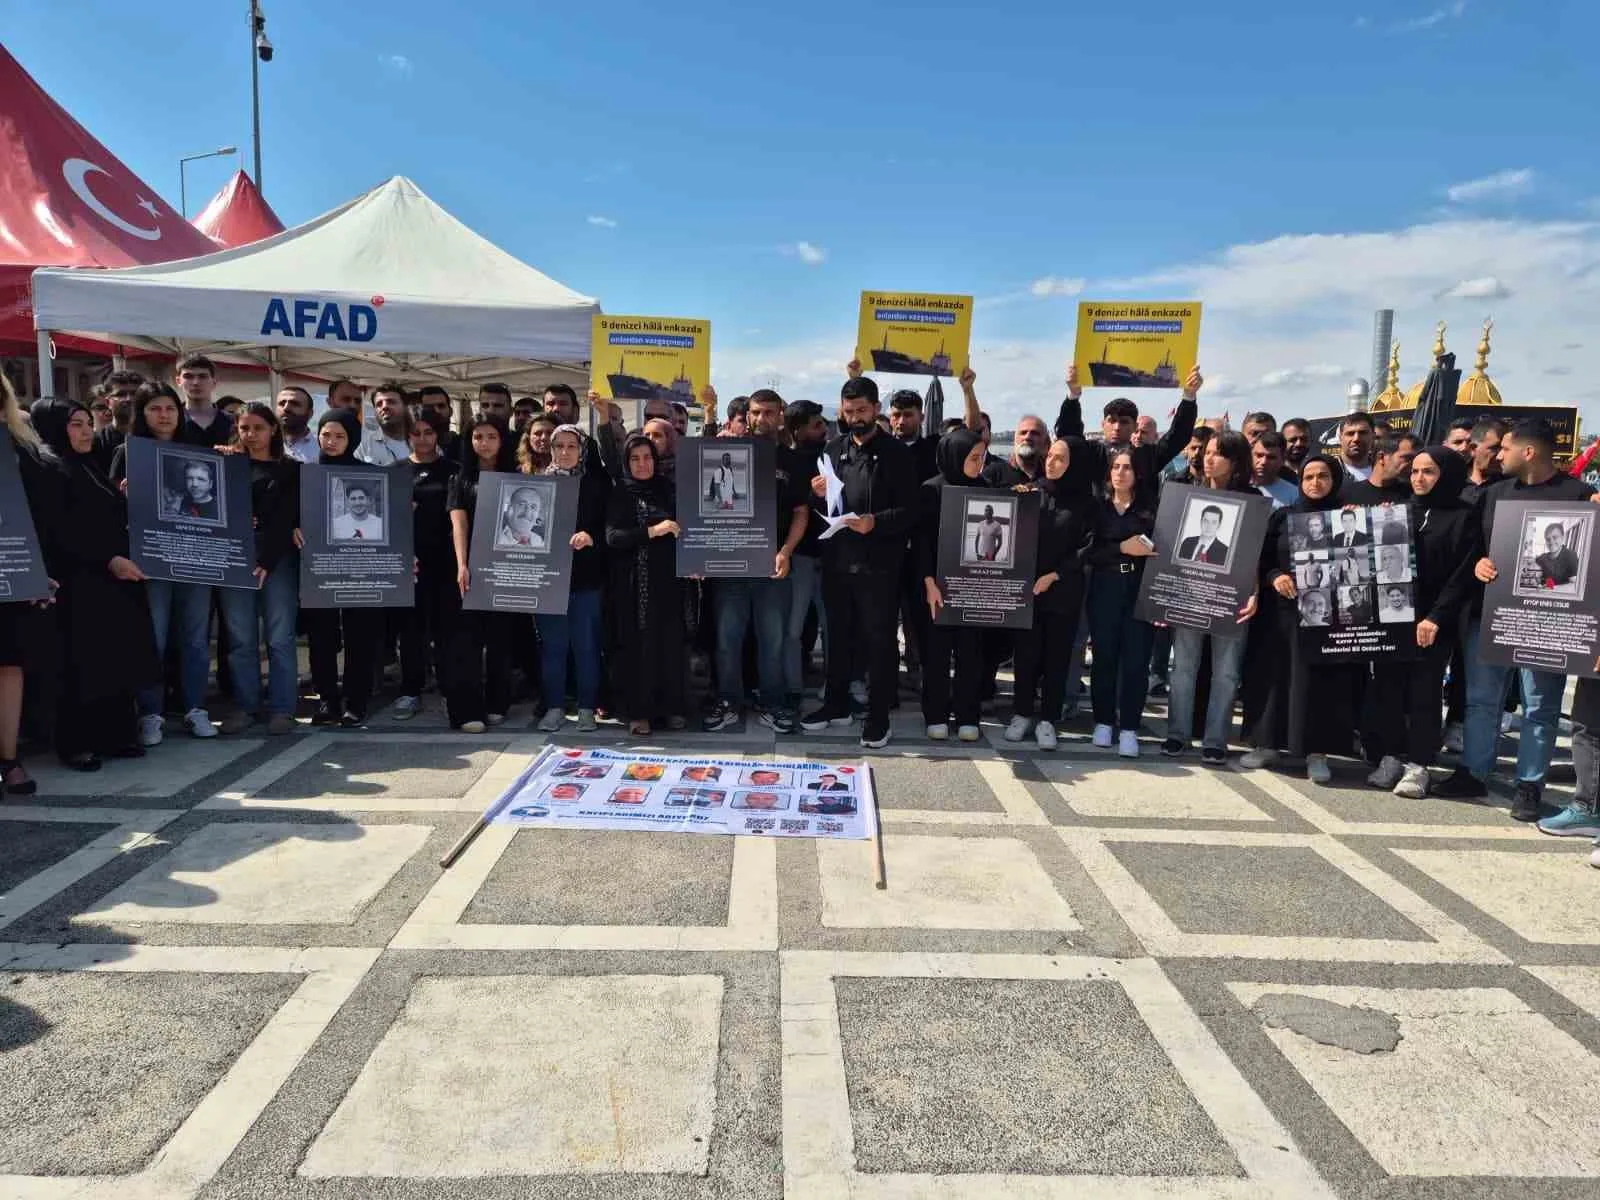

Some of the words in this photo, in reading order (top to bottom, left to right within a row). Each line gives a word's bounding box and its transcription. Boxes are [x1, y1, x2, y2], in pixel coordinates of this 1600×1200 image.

[869, 296, 875, 305] 9
[875, 296, 907, 306] denizci
[927, 298, 964, 309] enkazda
[1087, 308, 1093, 317] 9
[1094, 307, 1128, 317] denizci
[1151, 308, 1192, 317] enkazda
[260, 298, 377, 342] AFAD
[601, 320, 607, 329] 9
[609, 320, 641, 331] denizci
[663, 322, 702, 334] enkazda
[1386, 416, 1417, 430] Silivr
